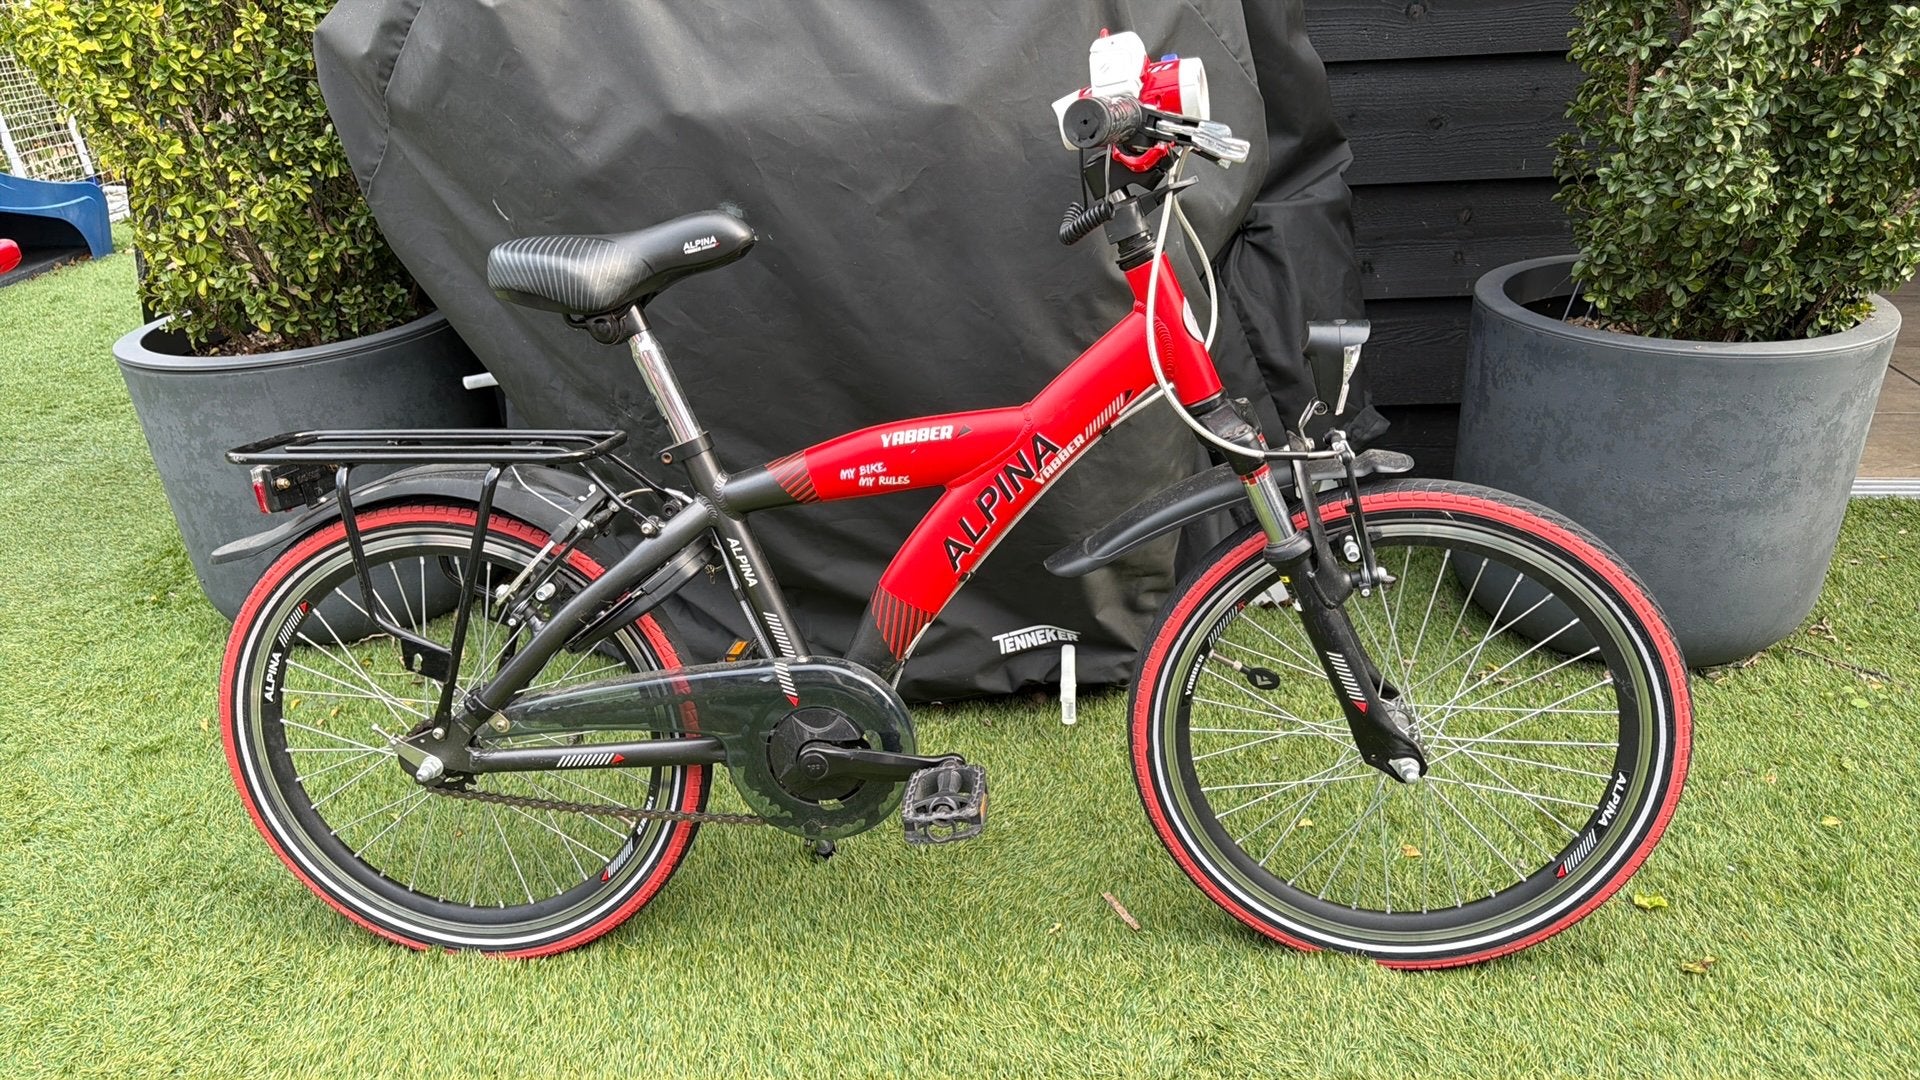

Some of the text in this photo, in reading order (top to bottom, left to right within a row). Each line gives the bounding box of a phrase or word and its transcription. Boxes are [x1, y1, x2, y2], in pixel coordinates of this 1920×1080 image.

[683, 235, 717, 250] ALPINA
[881, 425, 954, 448] YABBER
[840, 468, 856, 480] MY
[1034, 433, 1085, 485] YABBER
[859, 475, 910, 487] MY RULES
[943, 432, 1063, 573] ALPINA
[726, 537, 759, 587] ALPINA
[992, 627, 1080, 655] TENNEKER
[264, 653, 282, 702] ALPINA
[1598, 772, 1626, 826] ALPINA
